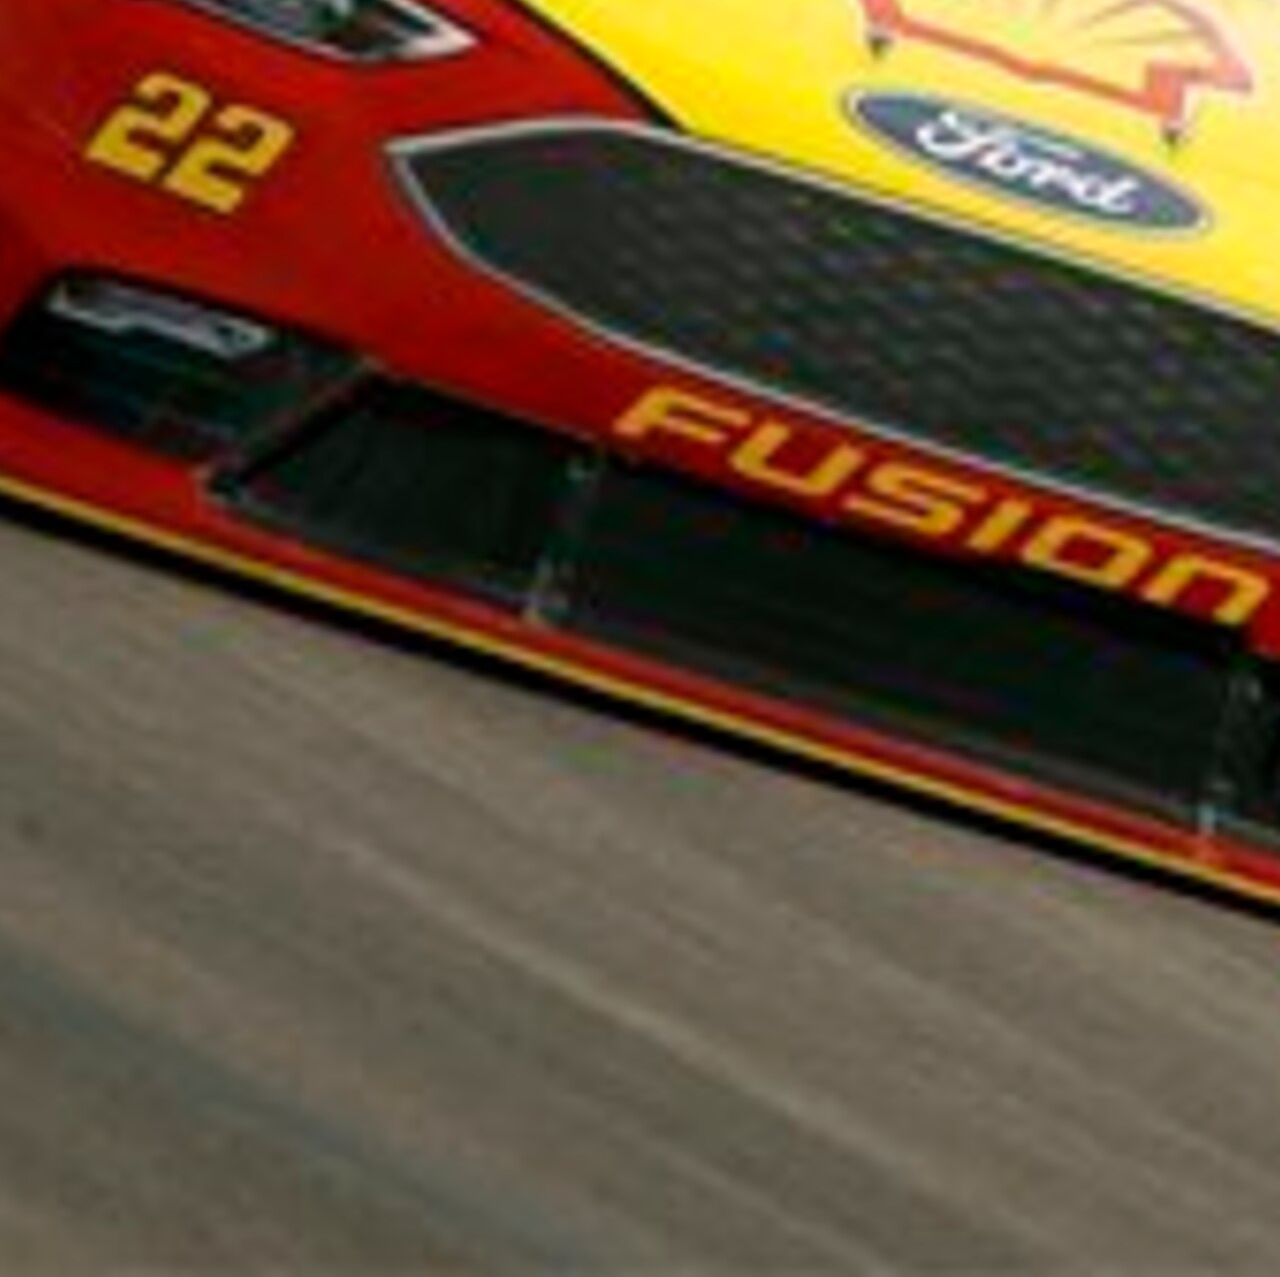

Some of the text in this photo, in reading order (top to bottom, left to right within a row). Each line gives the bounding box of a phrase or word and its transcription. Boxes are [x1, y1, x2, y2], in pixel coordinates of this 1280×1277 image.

[84, 70, 295, 214] 22
[916, 110, 1140, 215] Ford
[612, 386, 1272, 626] FUSION
